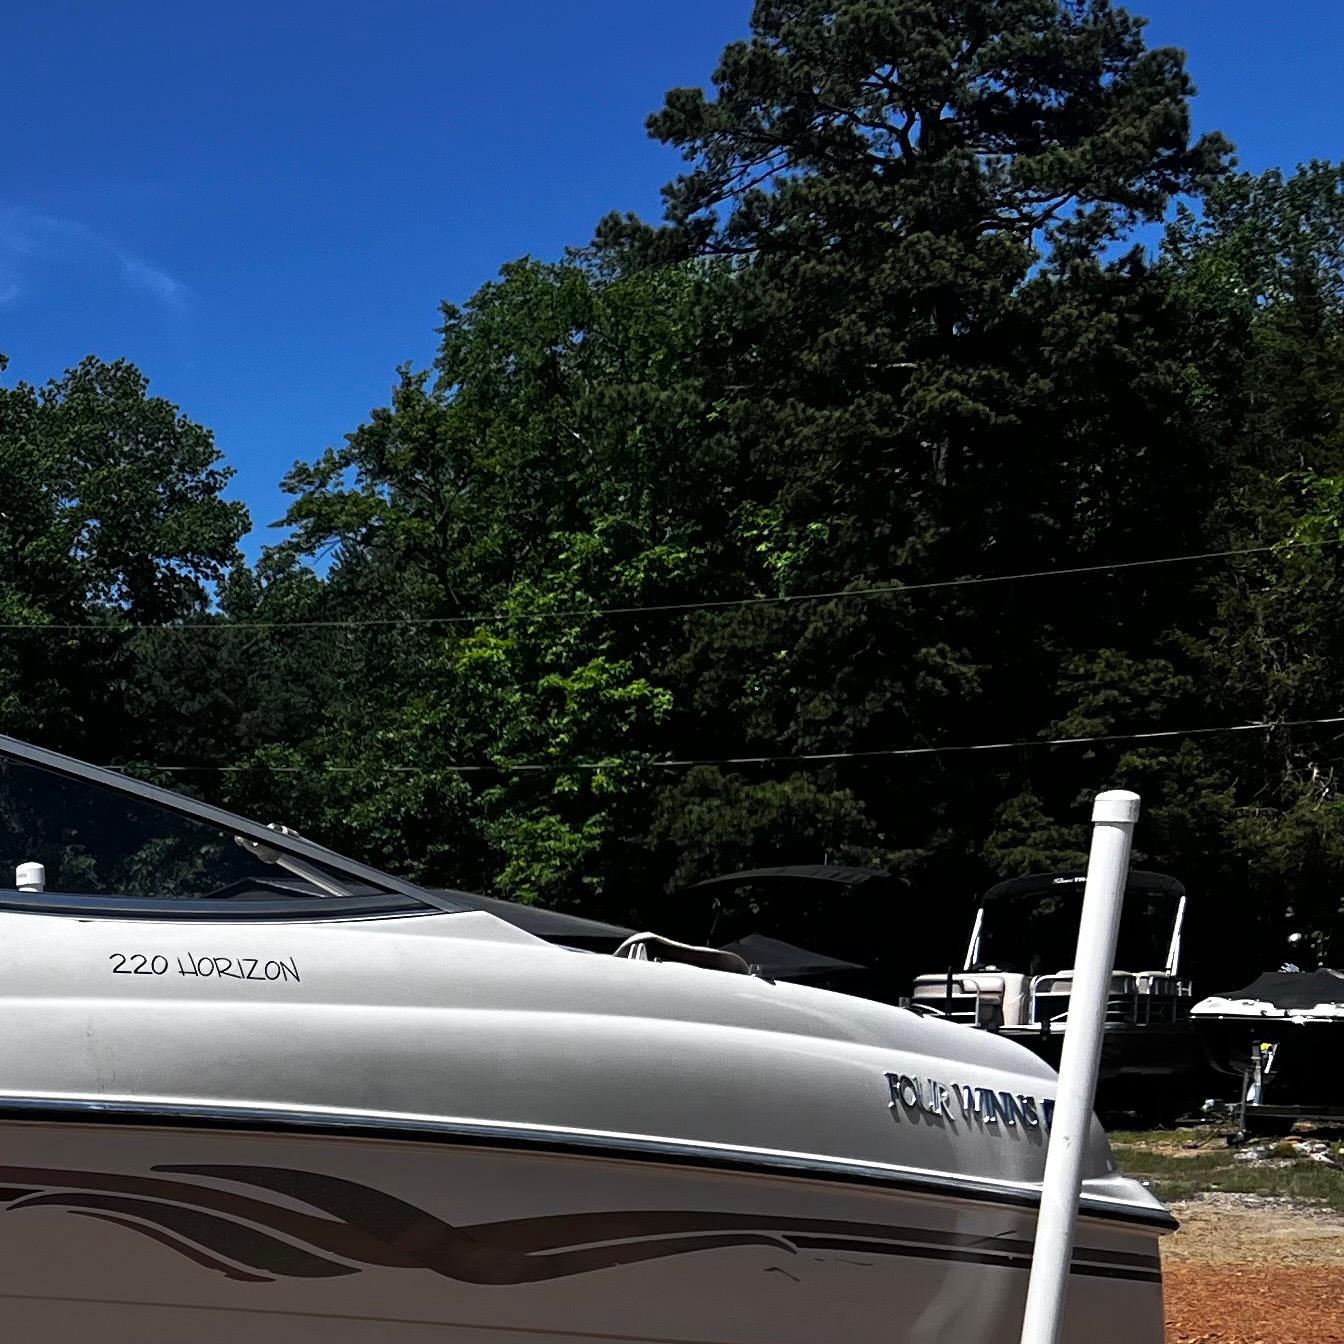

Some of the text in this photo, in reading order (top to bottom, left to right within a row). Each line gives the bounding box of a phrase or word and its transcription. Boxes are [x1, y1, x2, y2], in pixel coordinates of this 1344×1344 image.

[109, 951, 301, 983] 220 HORIZON
[883, 1071, 1039, 1130] FOUR WINNS
